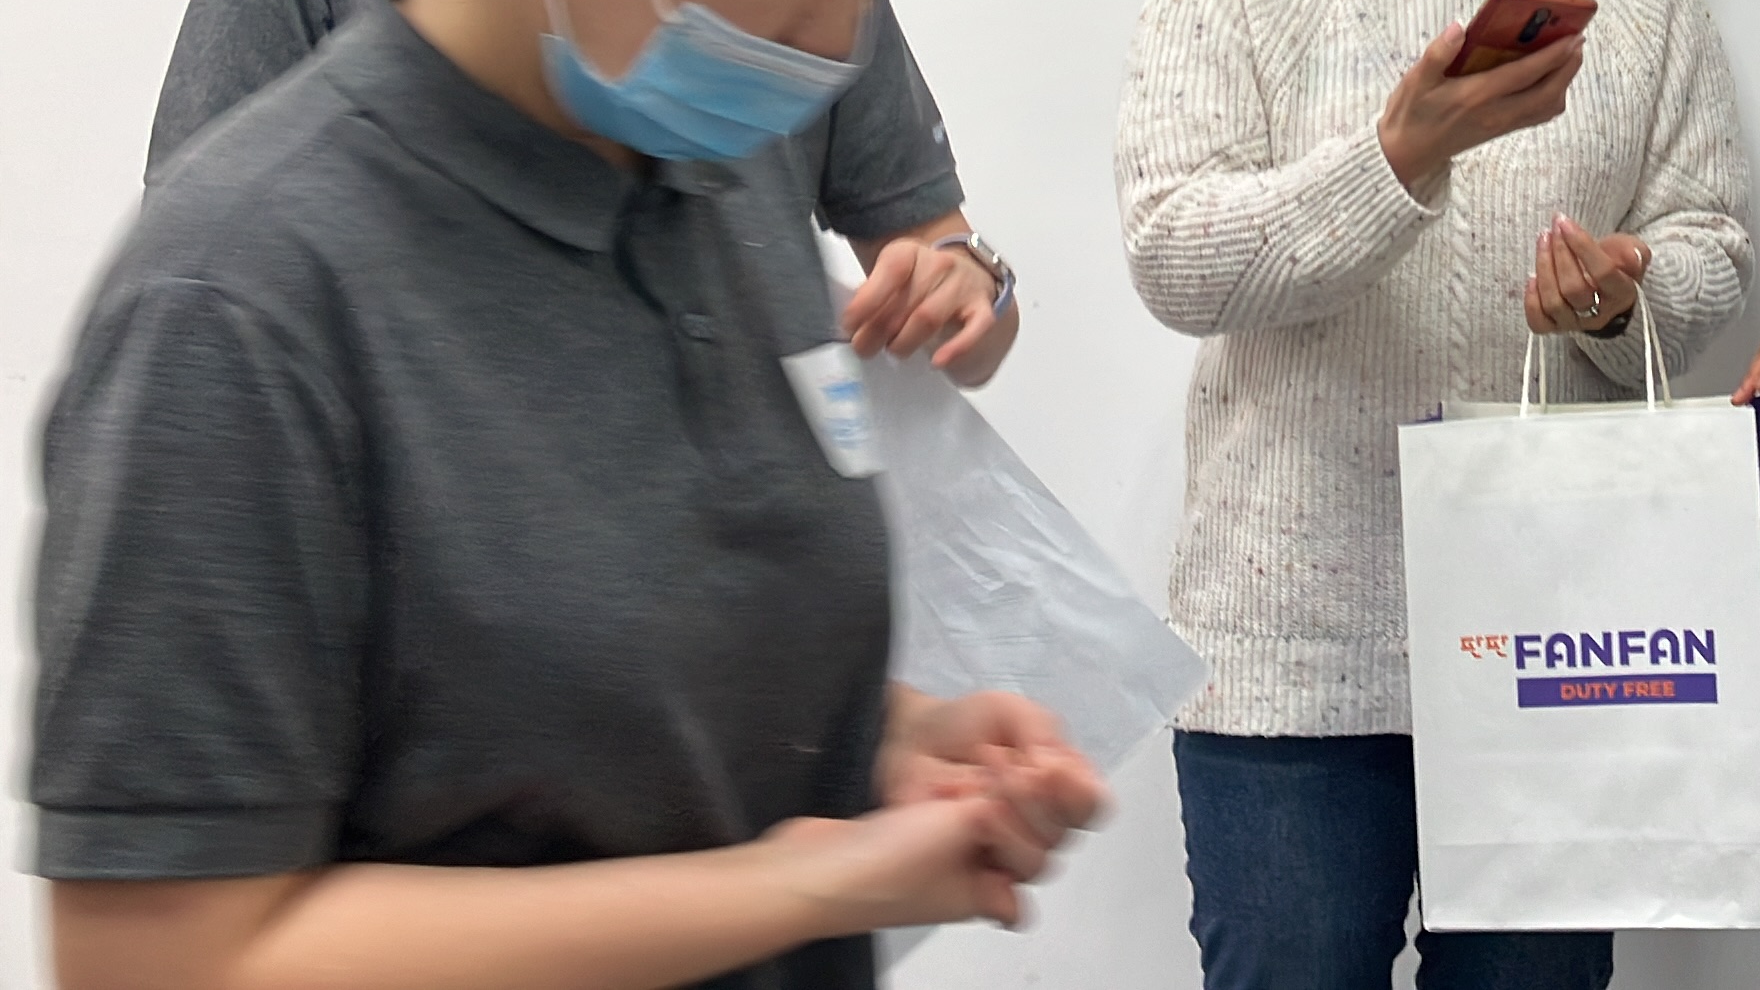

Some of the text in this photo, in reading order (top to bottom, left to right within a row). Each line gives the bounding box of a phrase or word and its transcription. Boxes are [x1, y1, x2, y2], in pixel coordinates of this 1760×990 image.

[1514, 629, 1716, 670] FANFAN
[1560, 680, 1676, 700] DUTY FREE
